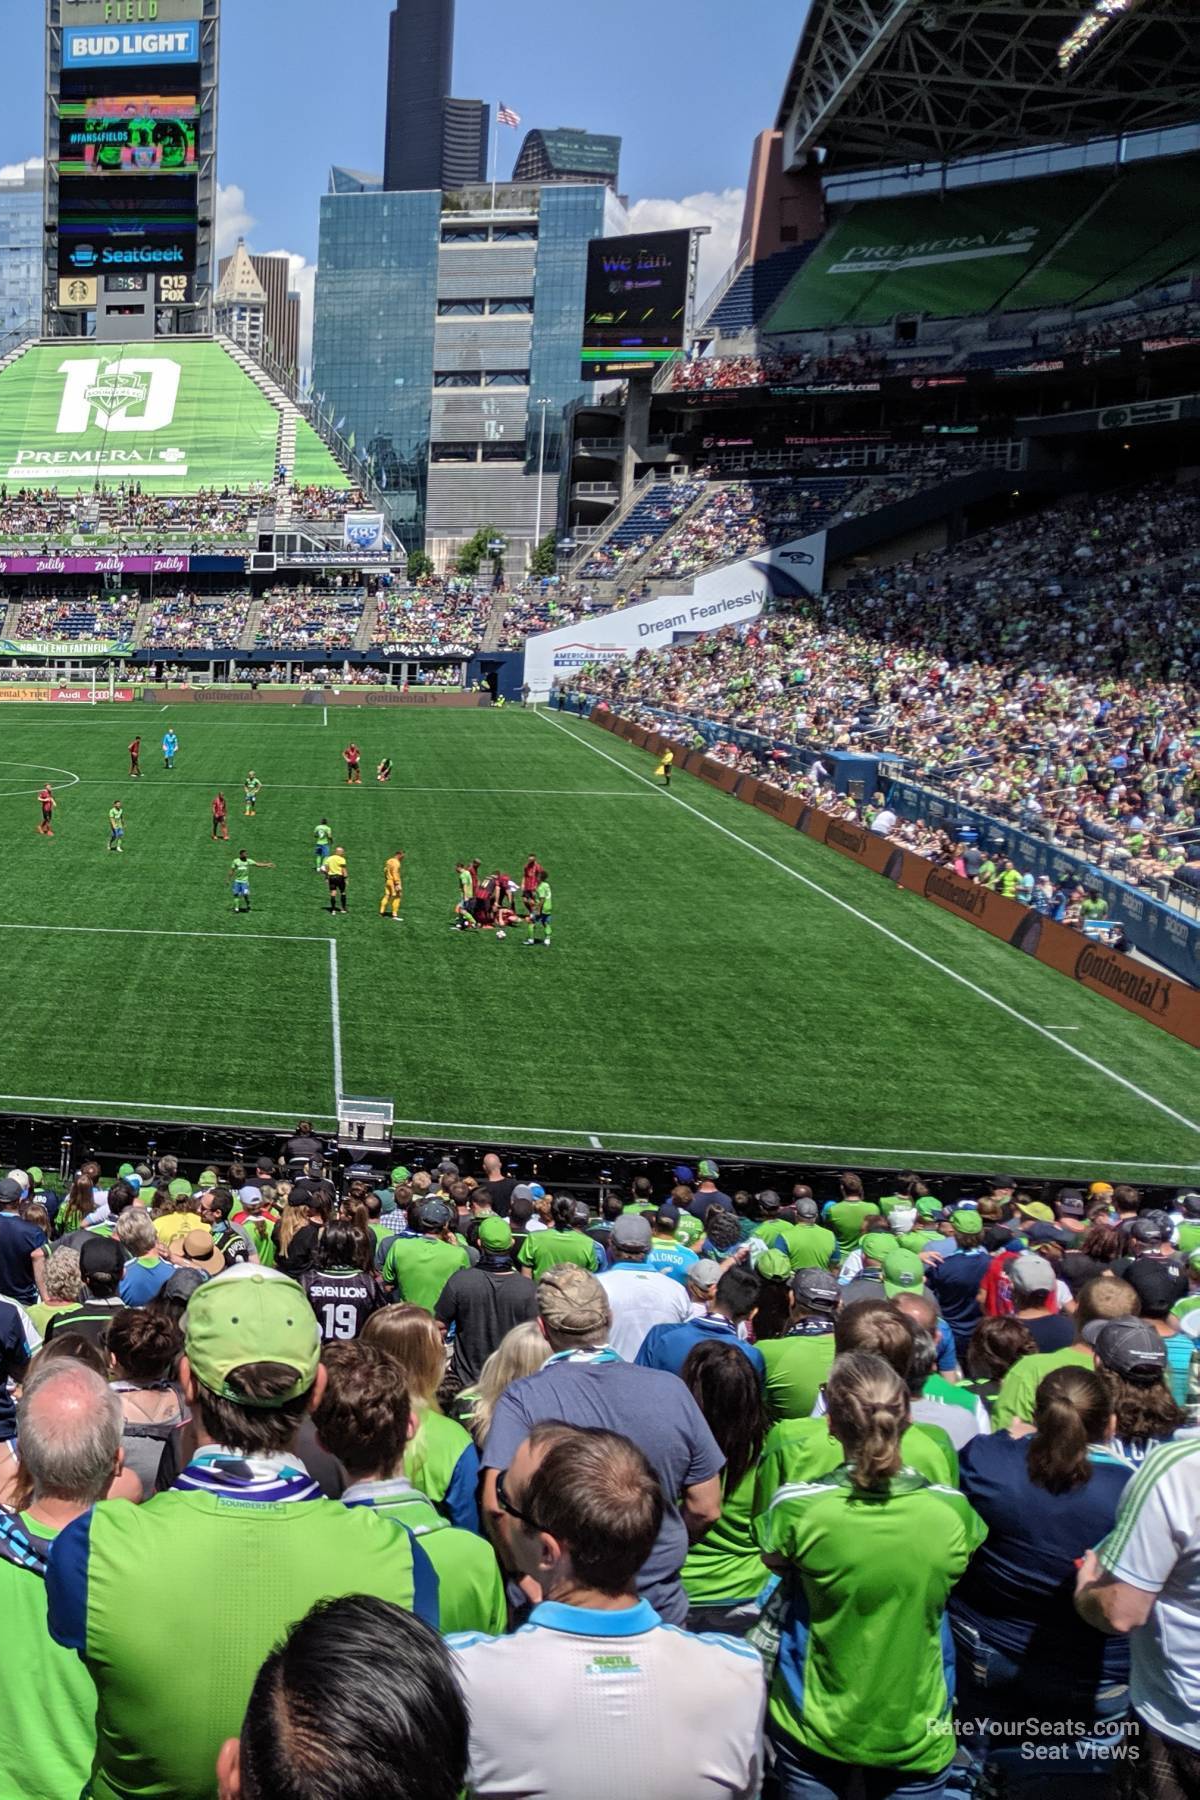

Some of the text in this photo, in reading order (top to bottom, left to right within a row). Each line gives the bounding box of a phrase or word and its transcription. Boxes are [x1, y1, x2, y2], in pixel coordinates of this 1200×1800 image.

[104, 2, 157, 21] FIELD
[72, 33, 189, 56] BUD LIGHT
[102, 244, 184, 263] SeatGeek
[842, 234, 986, 261] PREMERA
[160, 275, 187, 290] Q13
[161, 289, 186, 302] FOX
[56, 358, 182, 433] 10
[16, 450, 144, 464] PREMERA
[349, 527, 378, 539] 485
[638, 589, 765, 637] Dream Fearlessly
[20, 643, 108, 653] NORTH END FAITHFUL
[57, 691, 81, 699] Audi
[365, 692, 429, 704] Continental
[1074, 943, 1159, 1010] Continental
[310, 1286, 367, 1298] SEVEN LIONS
[322, 1303, 357, 1340] 19
